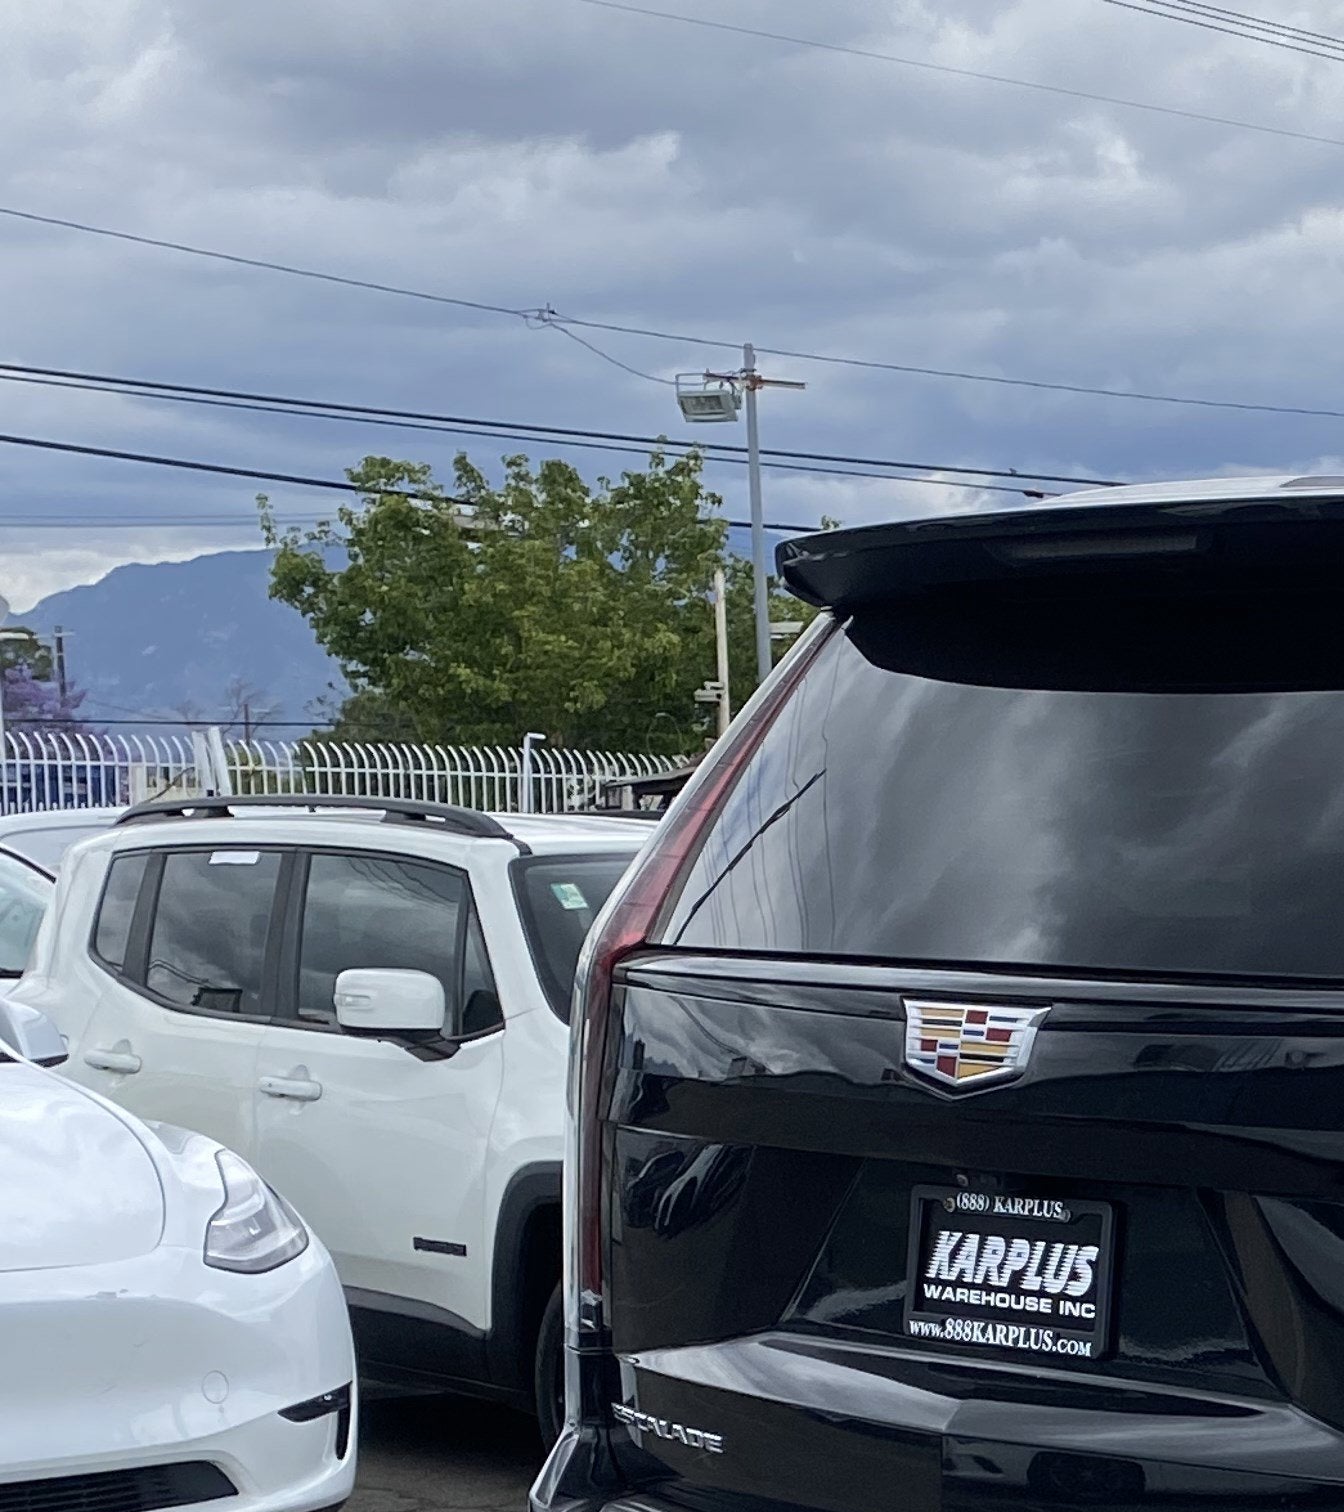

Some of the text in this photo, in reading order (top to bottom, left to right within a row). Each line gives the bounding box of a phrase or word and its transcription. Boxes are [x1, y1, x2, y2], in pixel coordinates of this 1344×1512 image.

[956, 1192, 1064, 1219] (888) KARPLUS
[925, 1230, 1099, 1297] KARPLUS
[923, 1283, 1097, 1319] WAREHOUSE INC
